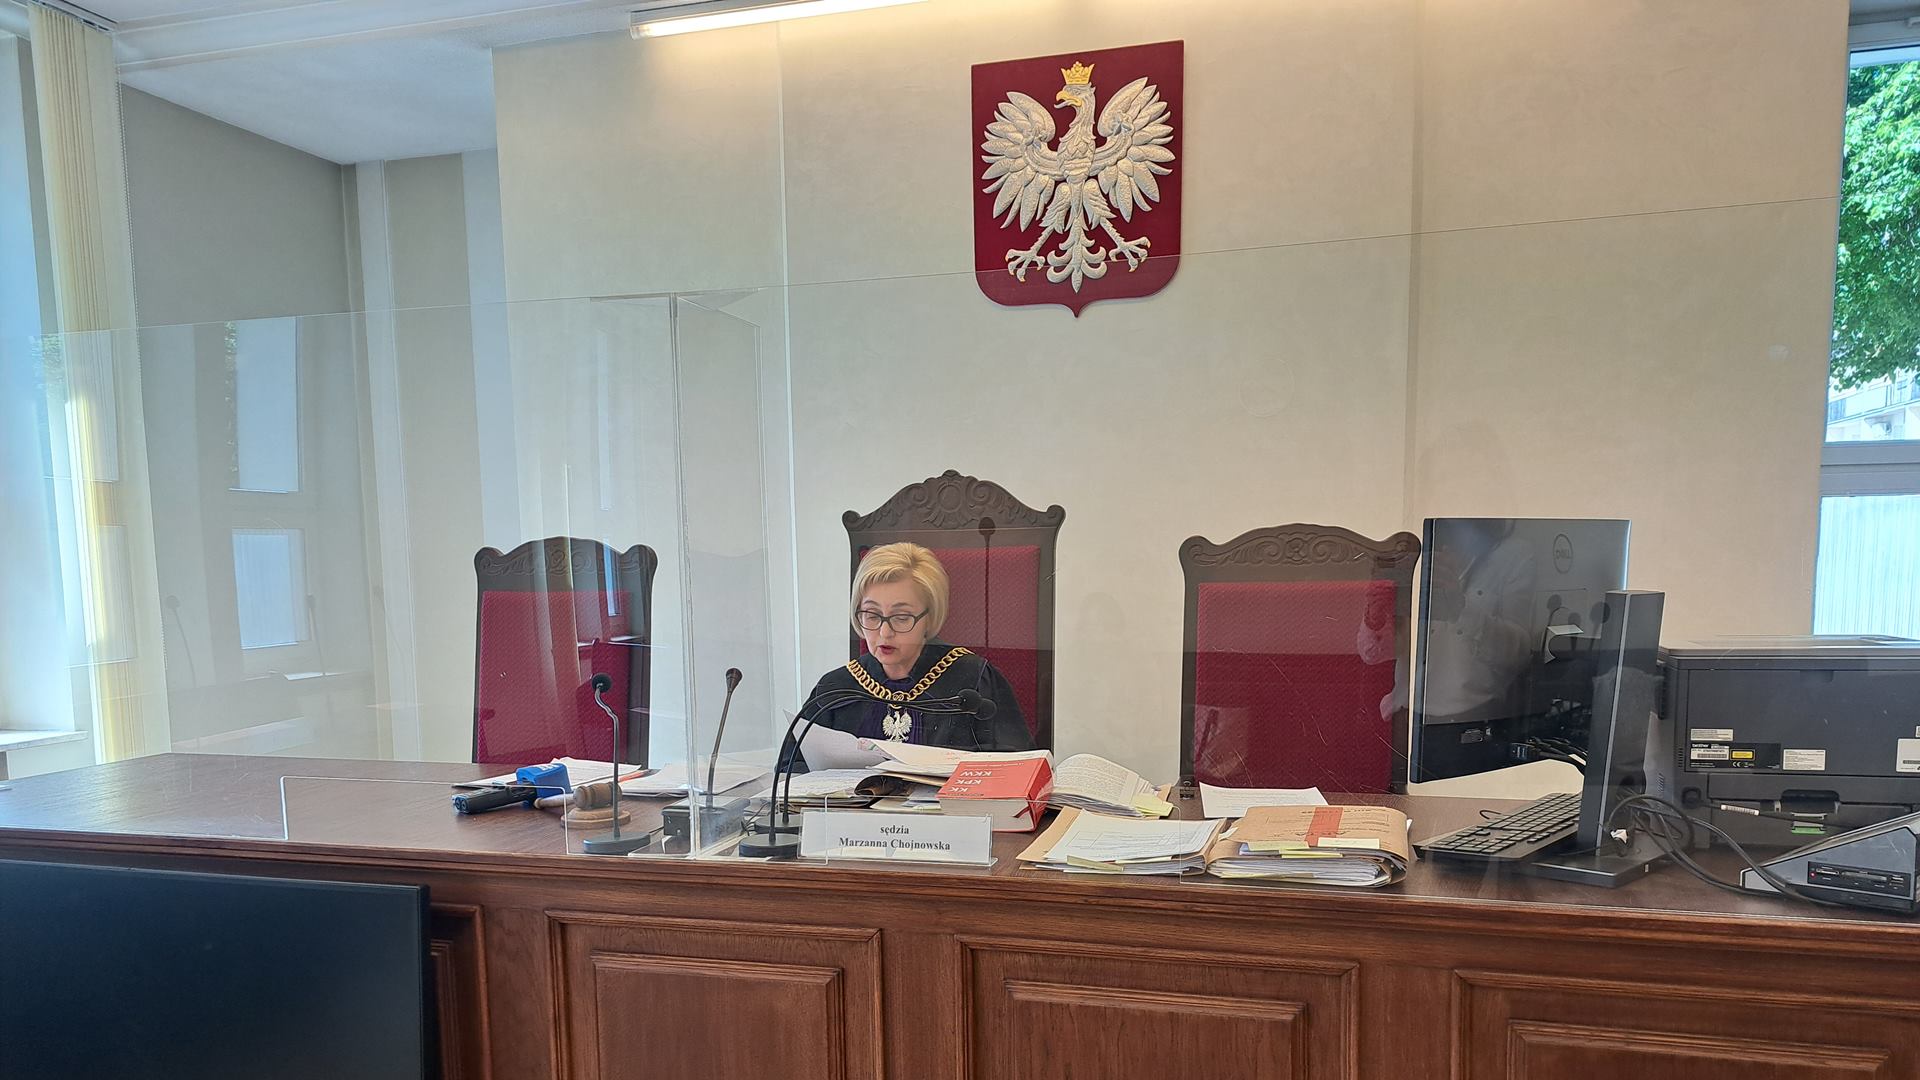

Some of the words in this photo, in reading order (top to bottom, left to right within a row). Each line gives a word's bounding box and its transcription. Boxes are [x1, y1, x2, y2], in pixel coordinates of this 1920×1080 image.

[880, 825, 909, 835] sędzia
[839, 837, 888, 848] Marzanna
[890, 839, 951, 851] Chojnowska
